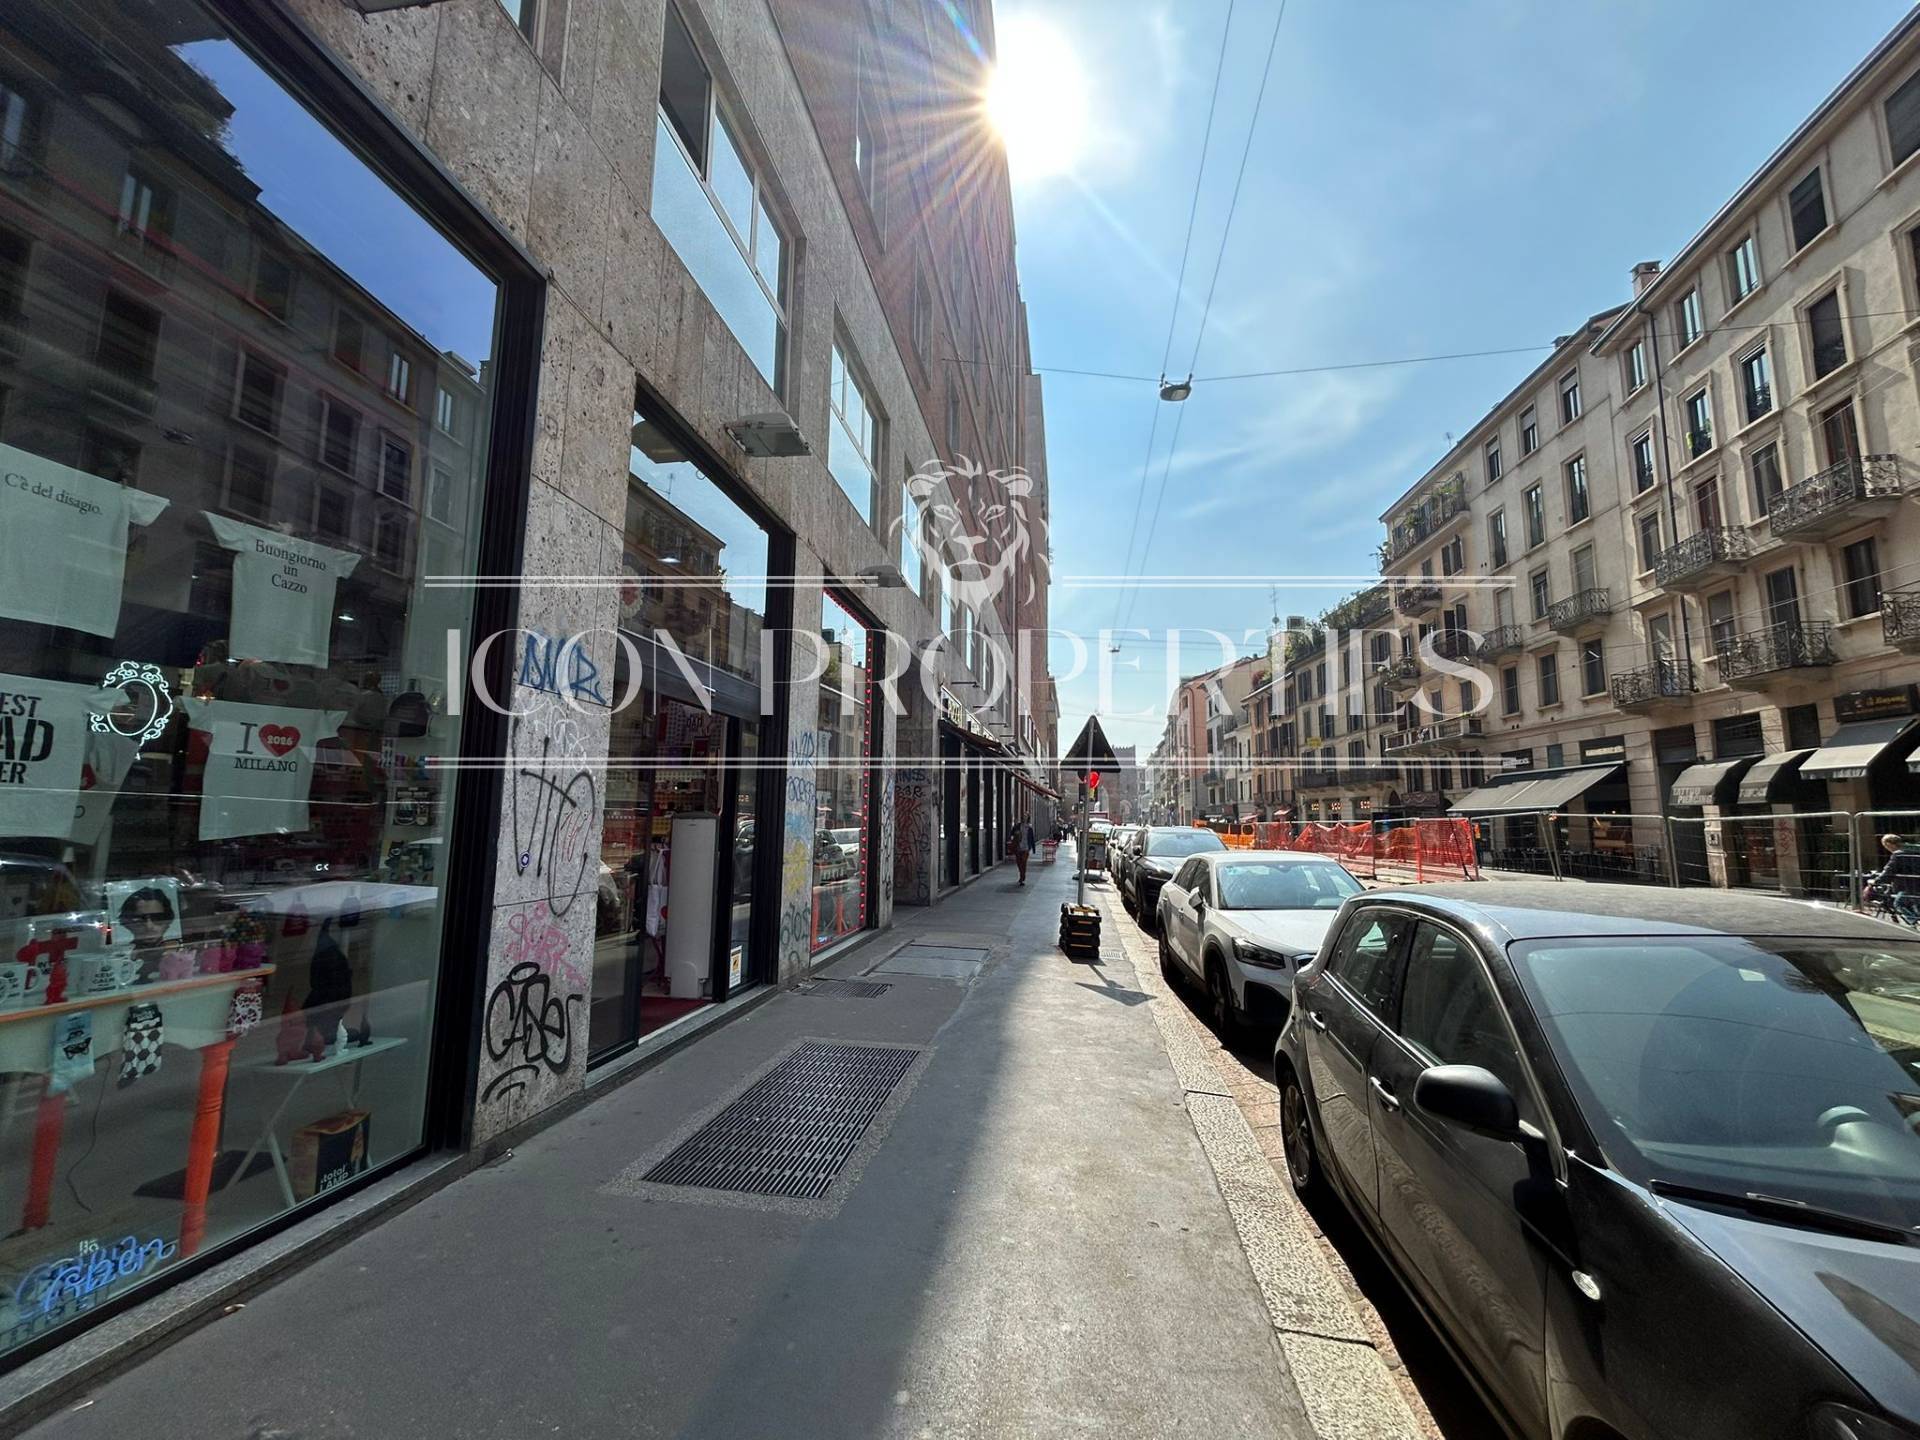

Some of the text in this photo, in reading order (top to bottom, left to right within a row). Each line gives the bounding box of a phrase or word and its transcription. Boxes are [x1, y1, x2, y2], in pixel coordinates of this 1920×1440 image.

[31, 482, 54, 499] del
[255, 538, 327, 571] Buongiorno
[283, 564, 298, 577] un
[271, 573, 308, 594] Cazzo
[236, 721, 258, 755] I
[233, 756, 299, 773] MILANO
